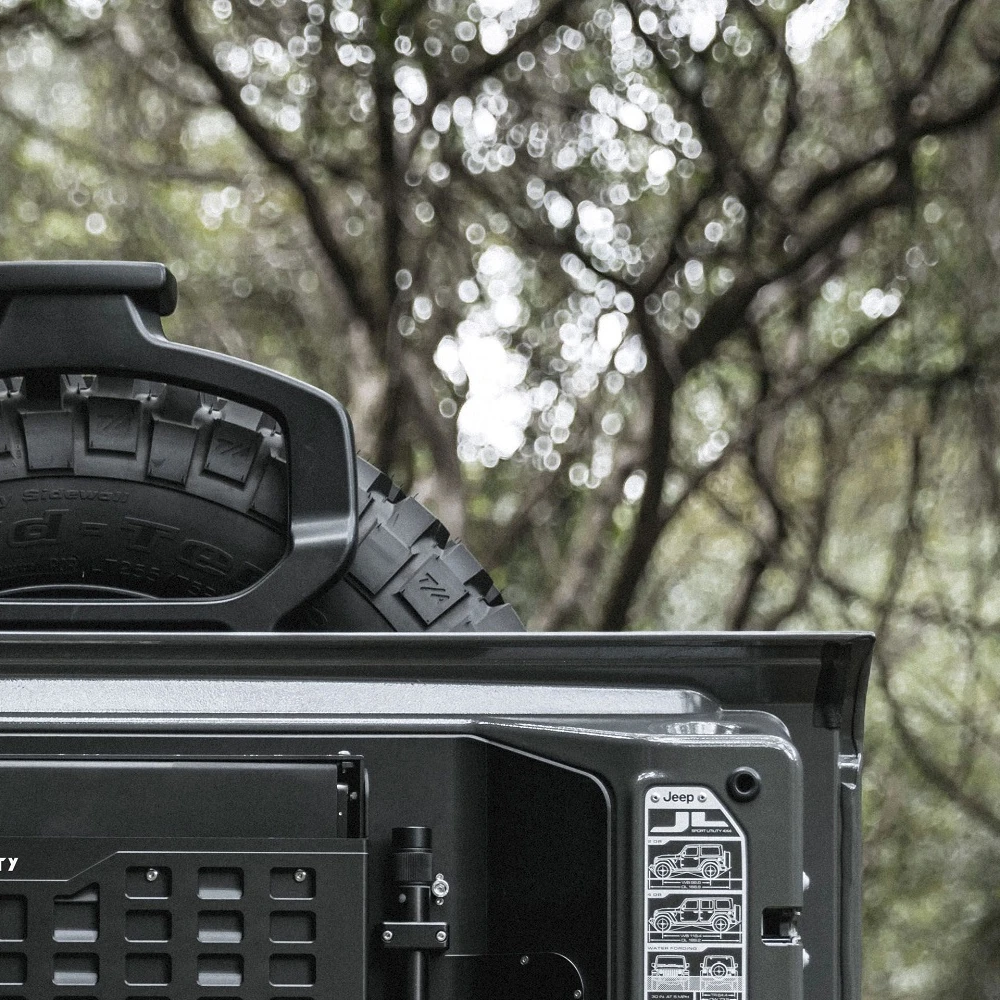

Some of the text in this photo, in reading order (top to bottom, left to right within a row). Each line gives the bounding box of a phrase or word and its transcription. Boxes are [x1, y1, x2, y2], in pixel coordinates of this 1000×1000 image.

[21, 488, 131, 504] Sidewall
[663, 791, 695, 804] Jeep
[650, 811, 729, 833] JL
